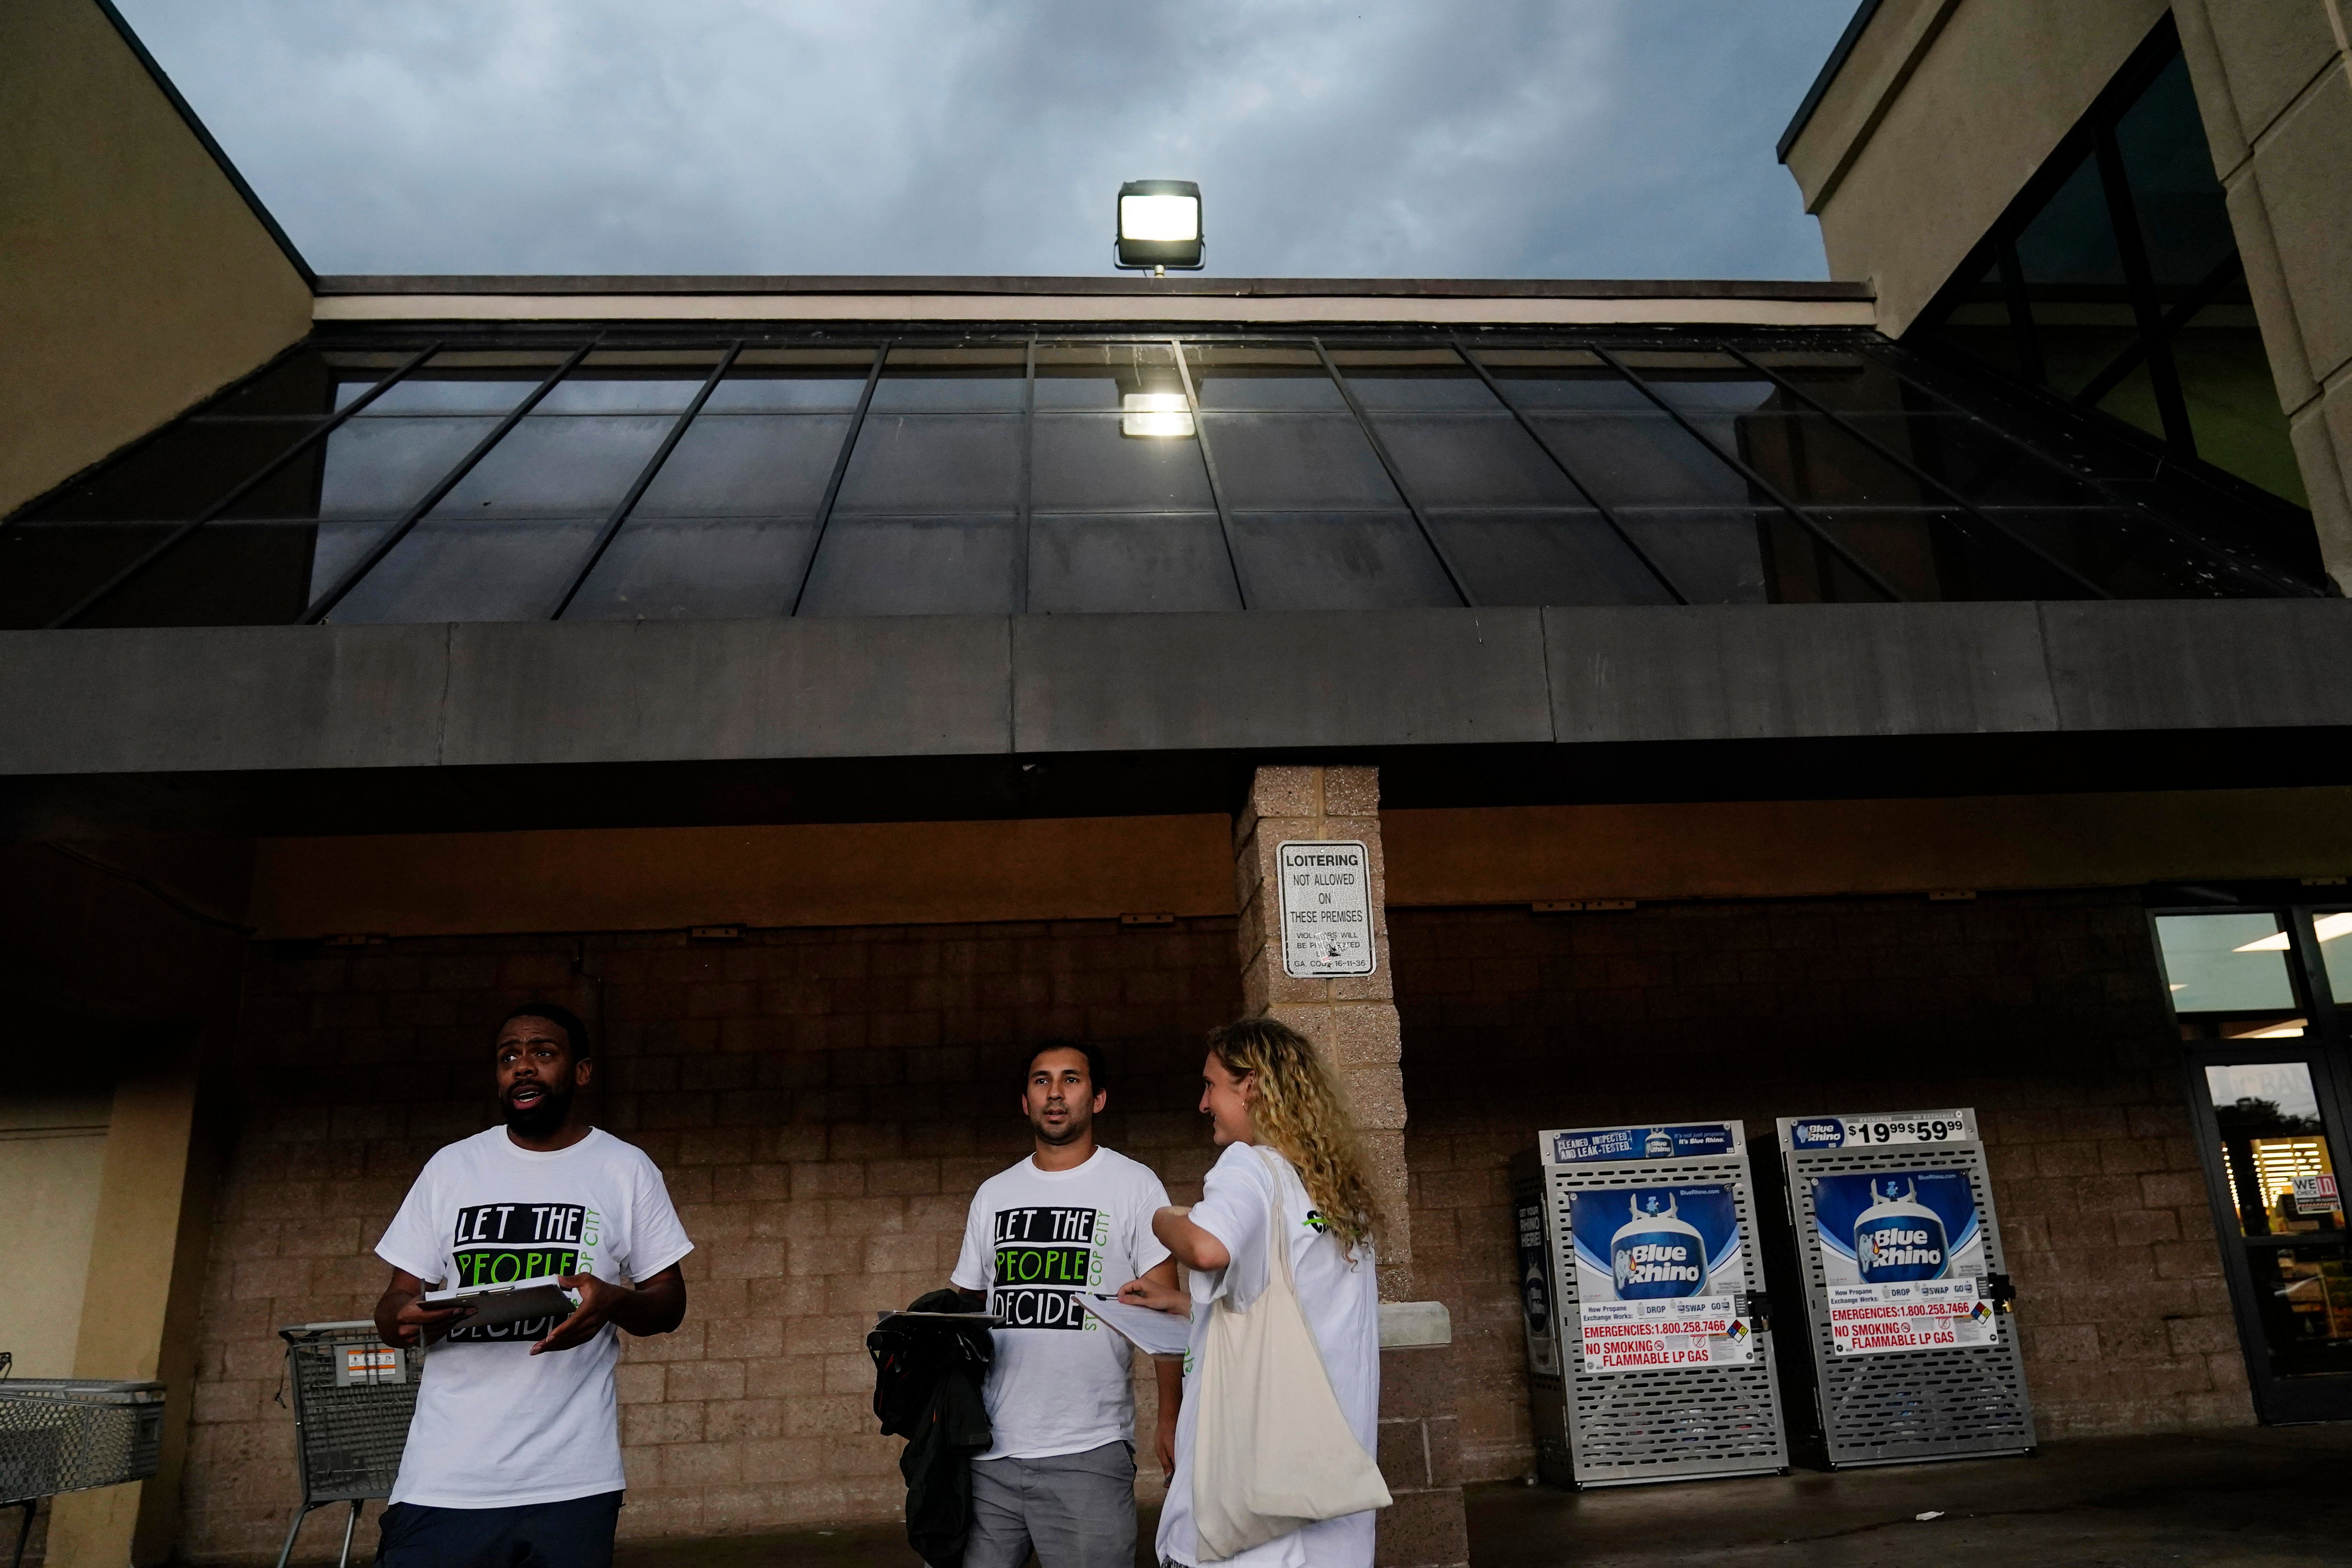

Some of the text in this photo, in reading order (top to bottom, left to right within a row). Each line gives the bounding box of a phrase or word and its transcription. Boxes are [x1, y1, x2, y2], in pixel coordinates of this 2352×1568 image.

[1287, 855, 1358, 866] LOITERING
[1293, 874, 1354, 886] NOT ALLOWED
[1319, 893, 1331, 904] ON
[1291, 910, 1363, 923] THESE PREMISES
[1809, 1125, 1834, 1133] Blue
[1561, 1149, 1576, 1160] AND
[2294, 1179, 2316, 1189] WE
[457, 1206, 581, 1243] LET THE
[584, 1208, 600, 1246] CITY
[995, 1210, 1093, 1242] LET THE
[1095, 1211, 1110, 1246] CITY
[1875, 1228, 1928, 1246] Blue
[1632, 1243, 1687, 1262] Blue
[1873, 1245, 1941, 1267] Rhino
[995, 1251, 1086, 1282] PEOPLE
[1090, 1251, 1103, 1286] COP
[1629, 1262, 1699, 1284] Rhino
[995, 1291, 1079, 1326] DECIDE
[1835, 1326, 1849, 1337] NO
[1852, 1322, 1900, 1336] SMOKING
[1586, 1343, 1600, 1354] NO
[1604, 1340, 1653, 1354] SMOKING
[1852, 1331, 1954, 1349] FLAMMABLE LP GAS
[1603, 1350, 1708, 1366] FLAMMABLE LP GAS
